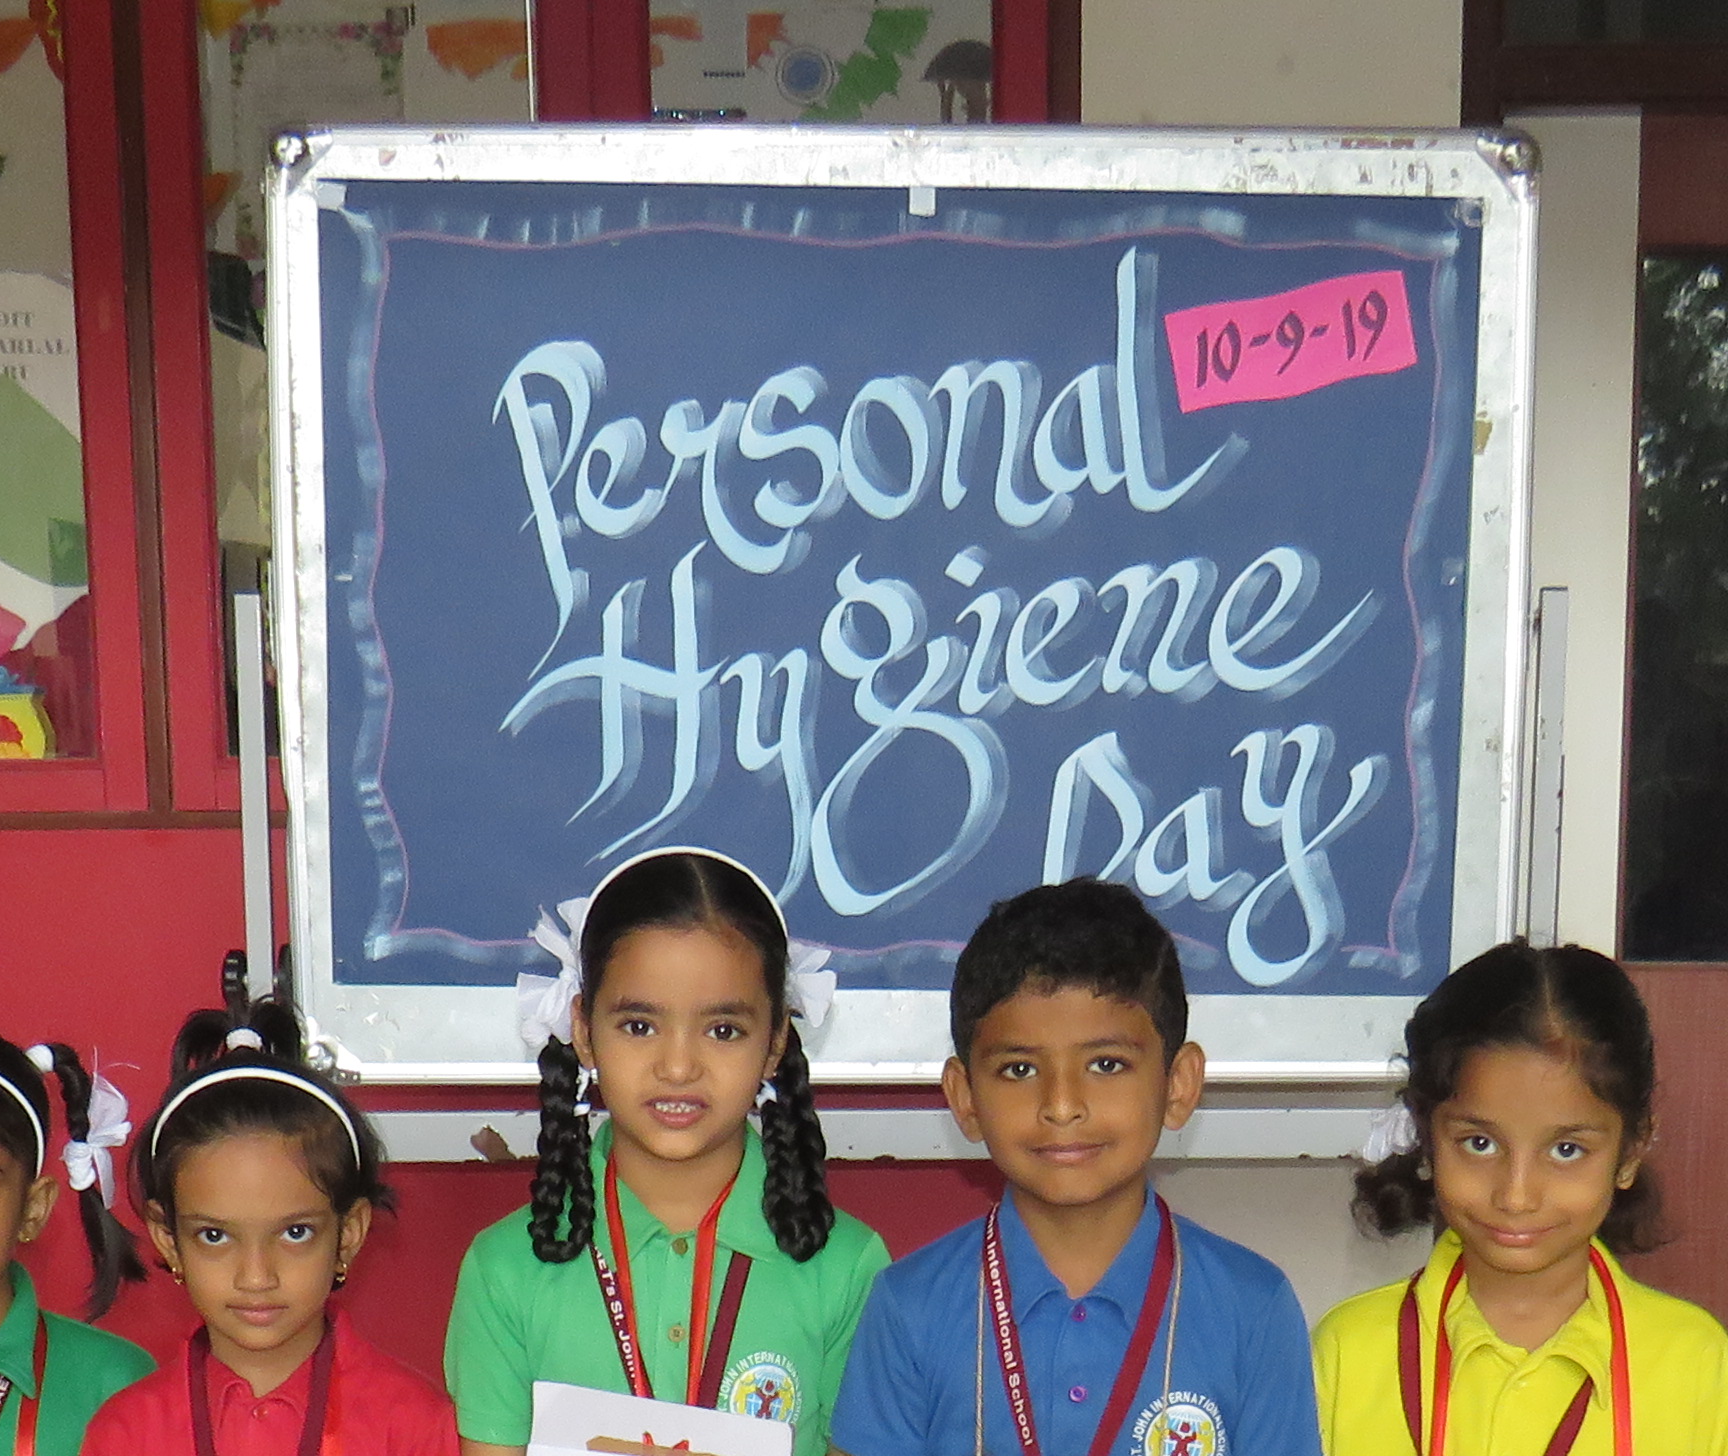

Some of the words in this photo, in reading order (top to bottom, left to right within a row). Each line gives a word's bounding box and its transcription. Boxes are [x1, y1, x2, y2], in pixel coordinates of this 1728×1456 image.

[1196, 289, 1388, 388] 10-9-19
[492, 246, 1248, 680] Personal
[499, 541, 1378, 916] Hygiene
[1042, 722, 1390, 987] Day
[718, 1367, 739, 1400] JOHN
[986, 1241, 1017, 1370] International
[1008, 1373, 1034, 1446] School
[1132, 1409, 1153, 1442] JOHN
